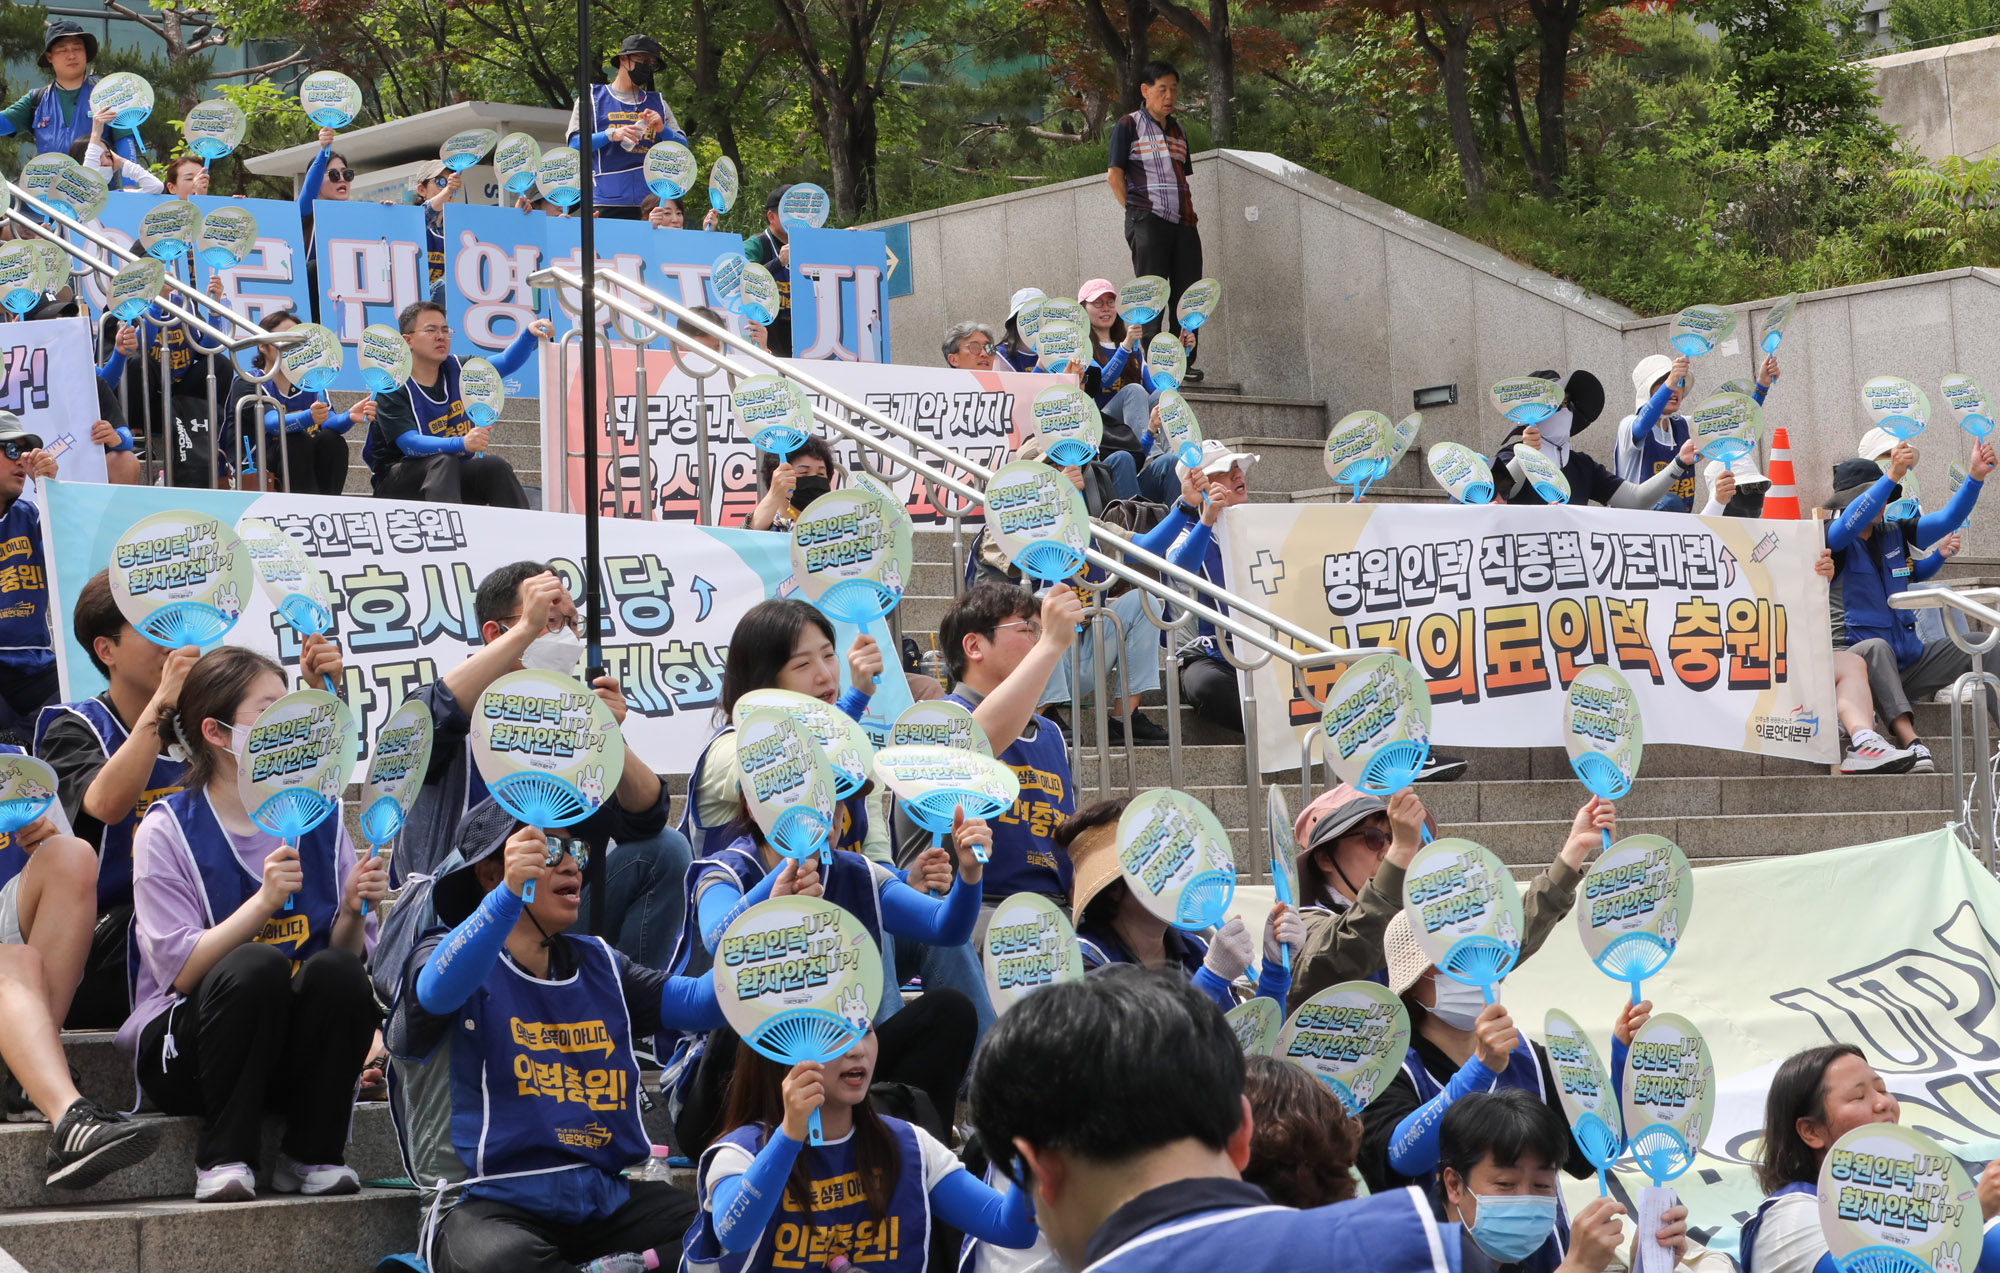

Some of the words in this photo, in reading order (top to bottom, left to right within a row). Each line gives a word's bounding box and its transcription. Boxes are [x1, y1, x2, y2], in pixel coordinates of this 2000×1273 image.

[328, 238, 420, 346] 민
[455, 230, 543, 351] 영
[800, 263, 881, 362] 지
[950, 391, 1015, 439] 저지!
[386, 508, 467, 555] 충원!
[1323, 539, 1473, 616] 병원인력
[1480, 531, 1589, 595] 직종별
[1591, 532, 1719, 590] 기준마련
[1669, 596, 1787, 692] 충원!
[1755, 724, 1811, 743] 의료연대본부
[573, 1026, 610, 1046] 아니다
